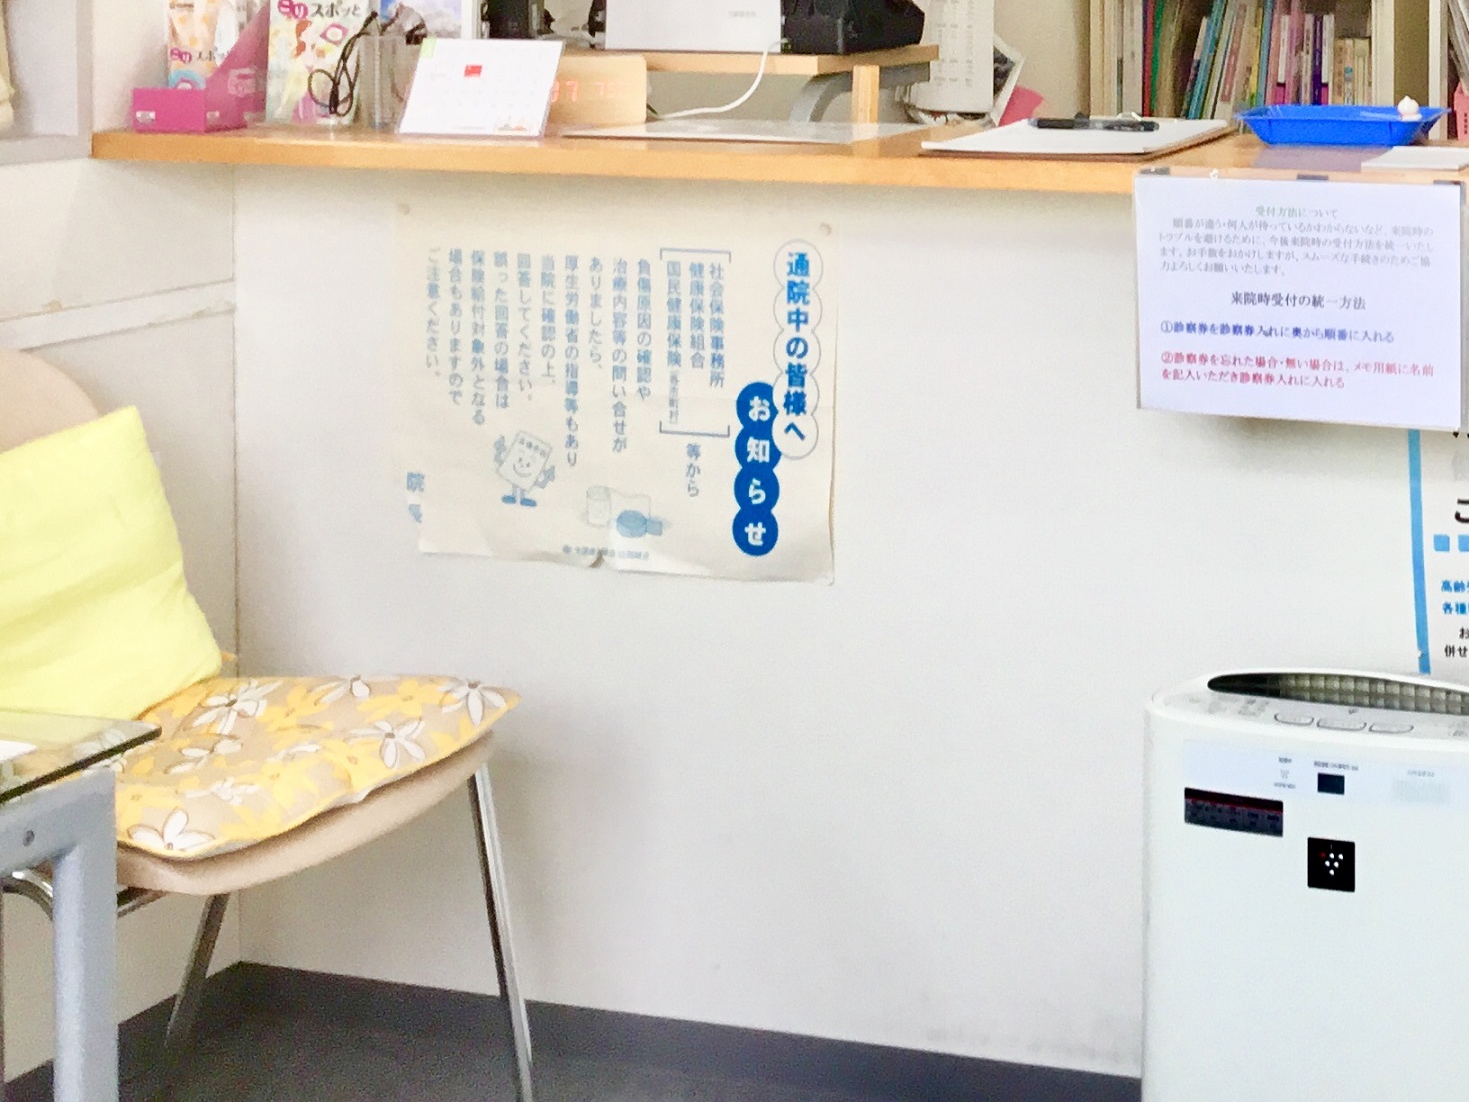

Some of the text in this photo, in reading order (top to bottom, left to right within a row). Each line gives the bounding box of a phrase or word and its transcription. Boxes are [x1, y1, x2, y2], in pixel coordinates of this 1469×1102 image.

[783, 251, 812, 441] 通院中の皆様へ
[1230, 291, 1367, 311] 来院時受付の統一方法
[743, 395, 773, 548] お知らせ
